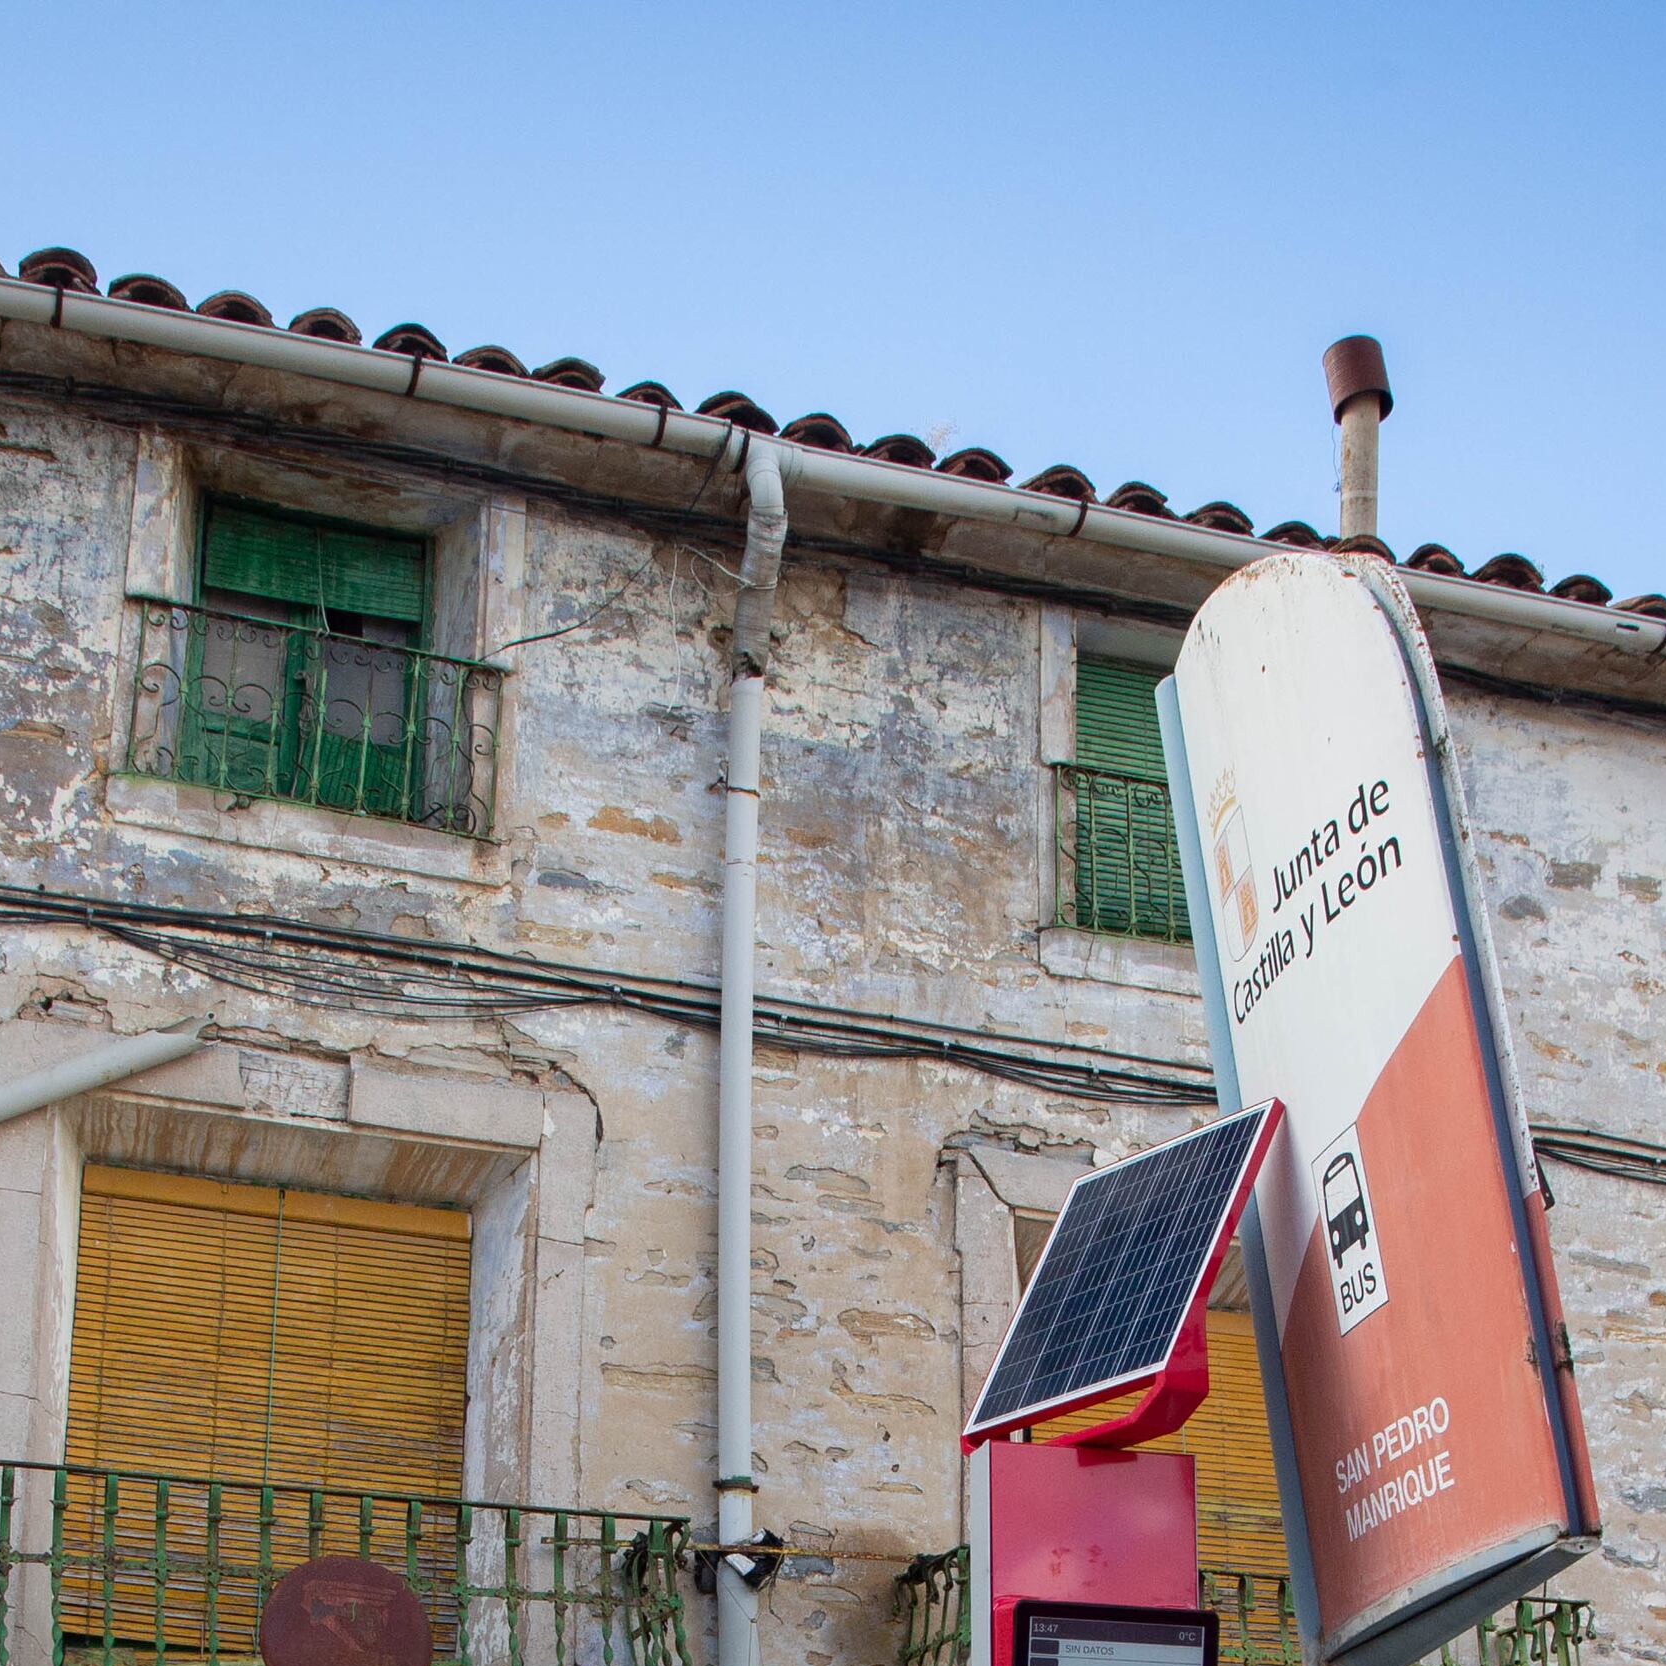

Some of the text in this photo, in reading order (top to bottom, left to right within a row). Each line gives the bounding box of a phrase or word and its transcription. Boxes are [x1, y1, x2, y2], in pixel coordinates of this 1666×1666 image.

[1271, 778, 1391, 914] Junta de
[1233, 834, 1402, 1025] Castilla y León
[1340, 1262, 1378, 1315] BUS
[1335, 1396, 1451, 1494] SAN PEDRO
[1345, 1450, 1455, 1542] MANRIQUE
[1033, 1622, 1197, 1642] 13:47 0°C
[1065, 1644, 1115, 1656] SIN DATOS
